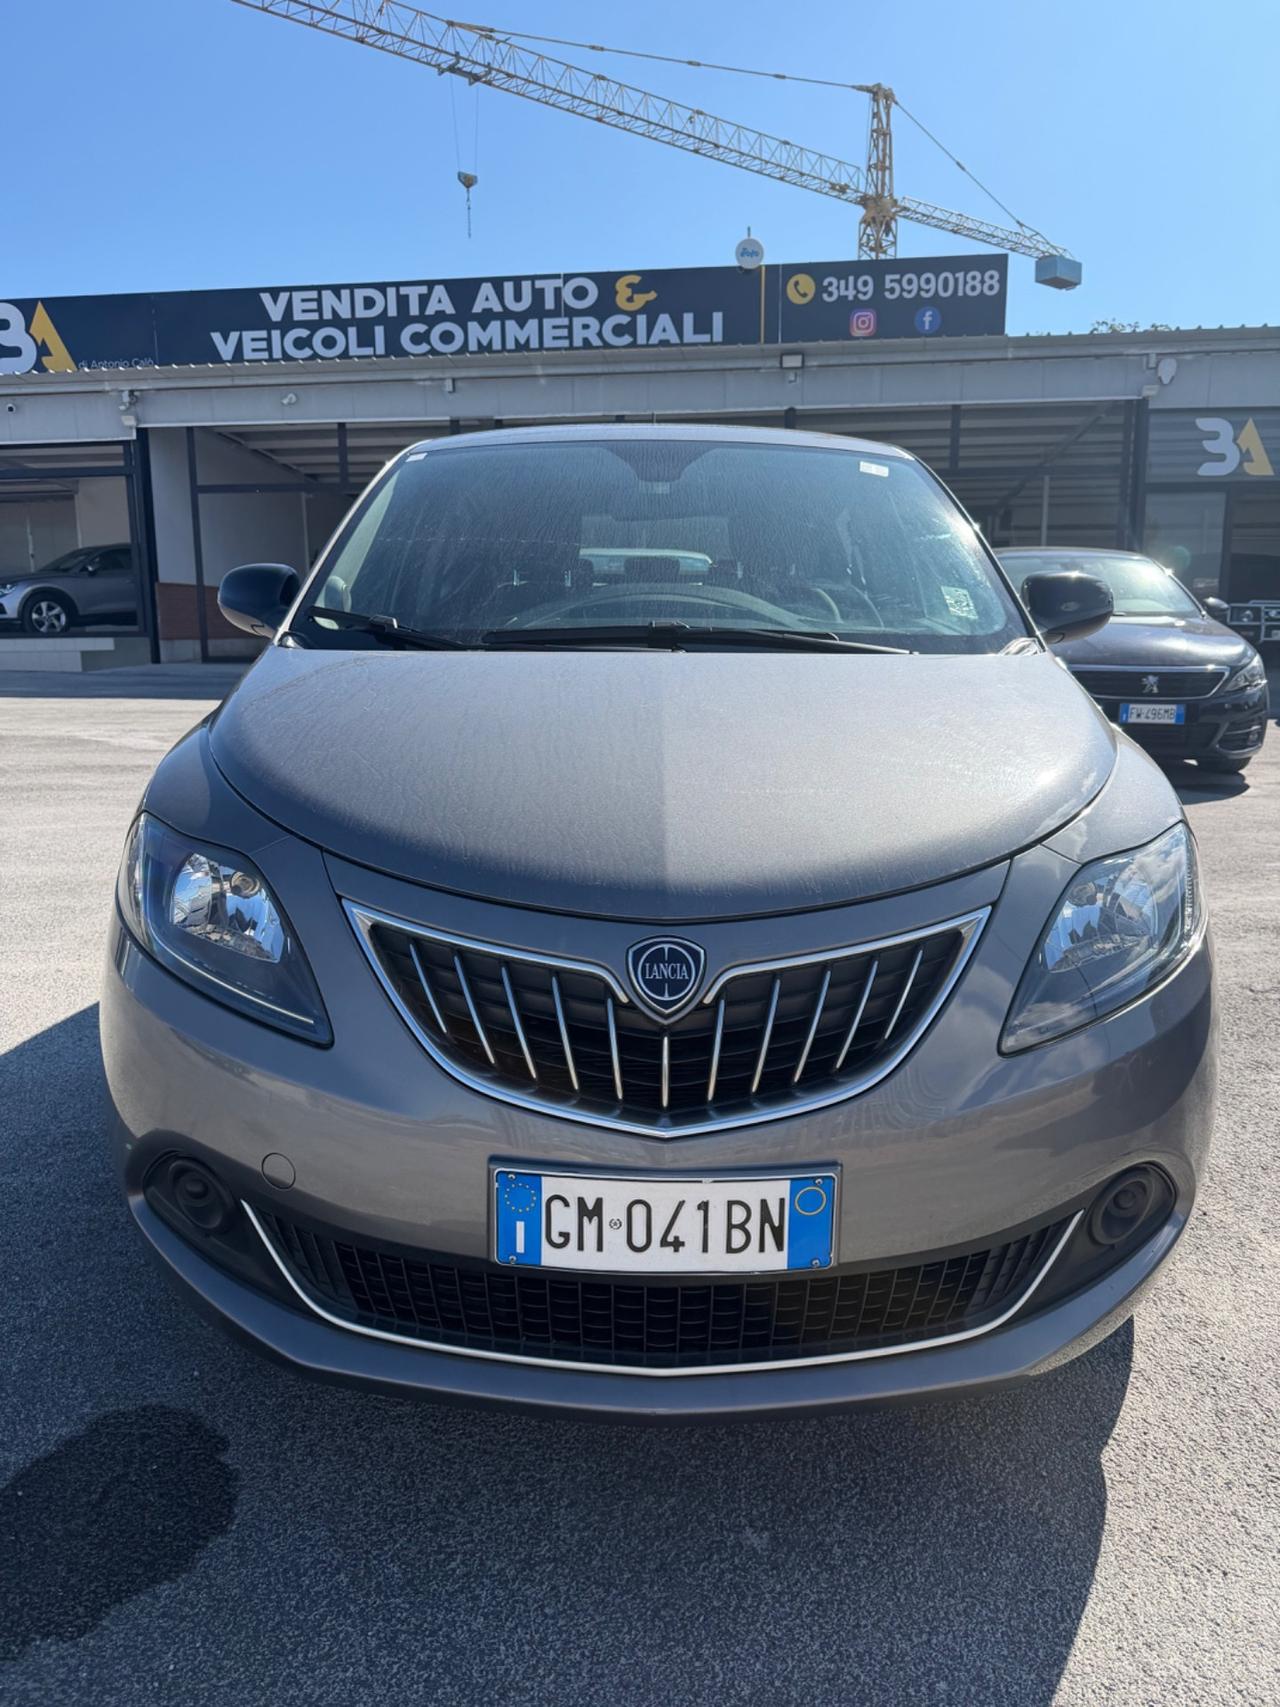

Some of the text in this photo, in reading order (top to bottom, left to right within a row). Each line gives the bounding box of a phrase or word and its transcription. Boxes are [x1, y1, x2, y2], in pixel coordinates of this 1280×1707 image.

[259, 274, 658, 322] VENDITA AUTO &
[822, 270, 1000, 302] 349 5990188
[210, 311, 723, 361] VEICOLI COMMERCIALI
[91, 358, 130, 369] Antonio
[645, 963, 689, 980] LANCIA
